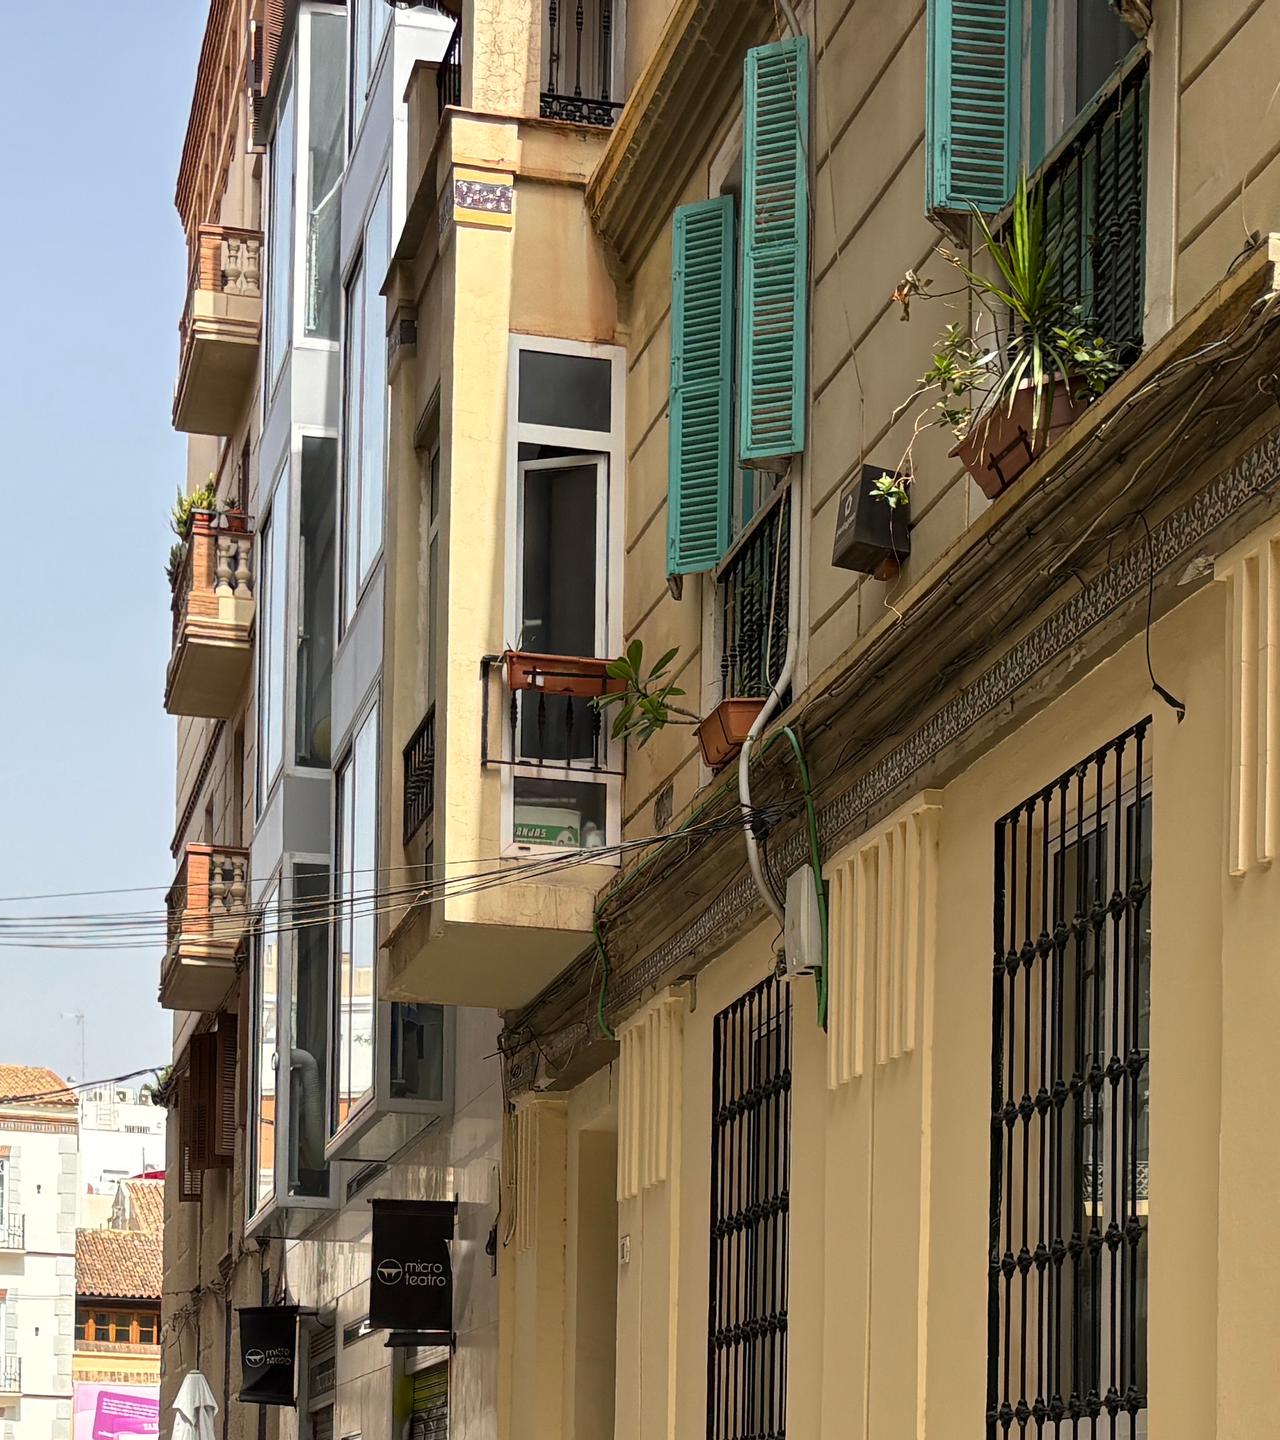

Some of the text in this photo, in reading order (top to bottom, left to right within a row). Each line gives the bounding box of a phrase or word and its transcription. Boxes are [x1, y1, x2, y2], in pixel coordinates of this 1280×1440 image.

[514, 826, 547, 838] ANJAS
[405, 1260, 443, 1273] micro
[405, 1273, 447, 1287] teatro
